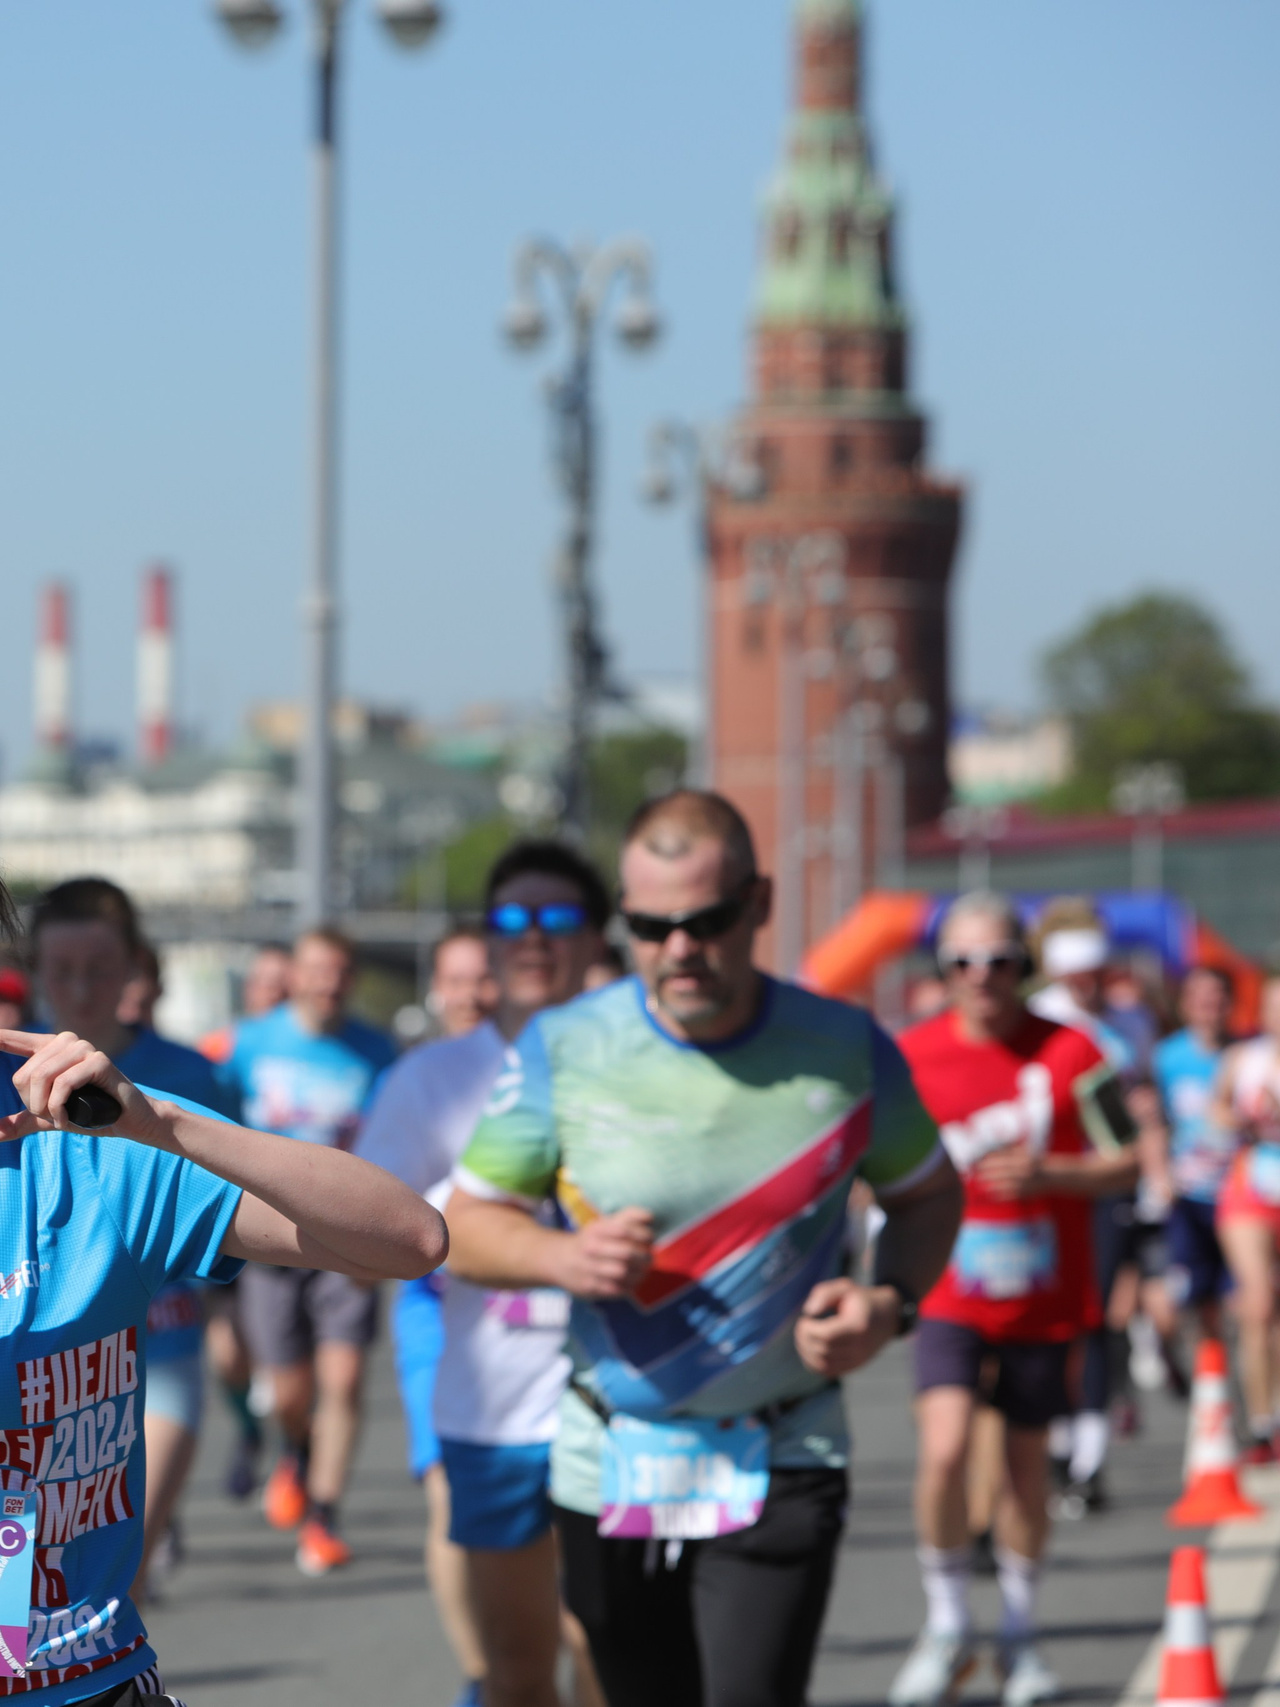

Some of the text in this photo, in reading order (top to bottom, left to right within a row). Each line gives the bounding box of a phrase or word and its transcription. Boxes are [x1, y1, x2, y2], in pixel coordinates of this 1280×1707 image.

[19, 1327, 138, 1426] #ЦЕЛЬ
[5, 1498, 24, 1506] FON
[4, 1505, 23, 1514] BET
